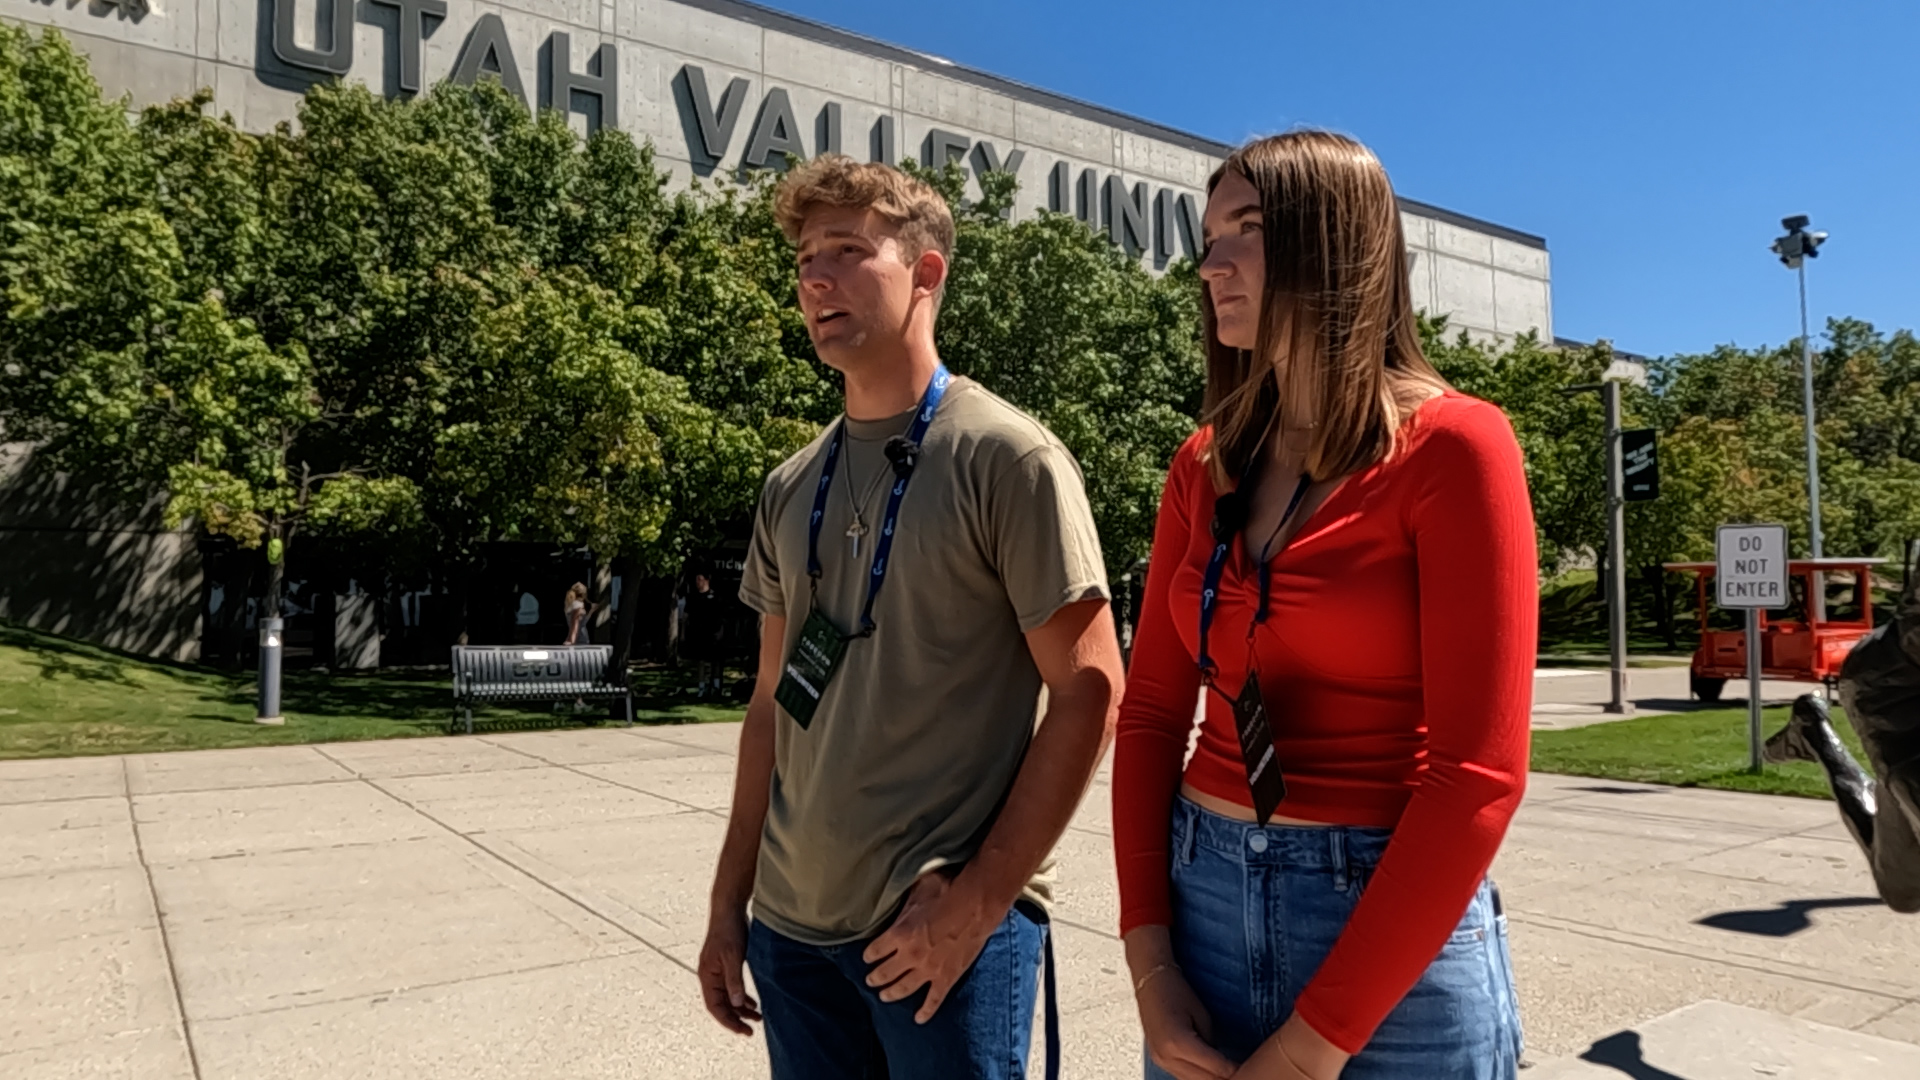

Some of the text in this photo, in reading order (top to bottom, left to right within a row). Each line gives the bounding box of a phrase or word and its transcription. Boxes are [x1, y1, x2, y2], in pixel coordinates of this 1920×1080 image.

[271, 0, 618, 130] UTAH
[1738, 535, 1762, 552] DO
[1734, 558, 1769, 575] NOT
[1725, 581, 1779, 598] ENTER
